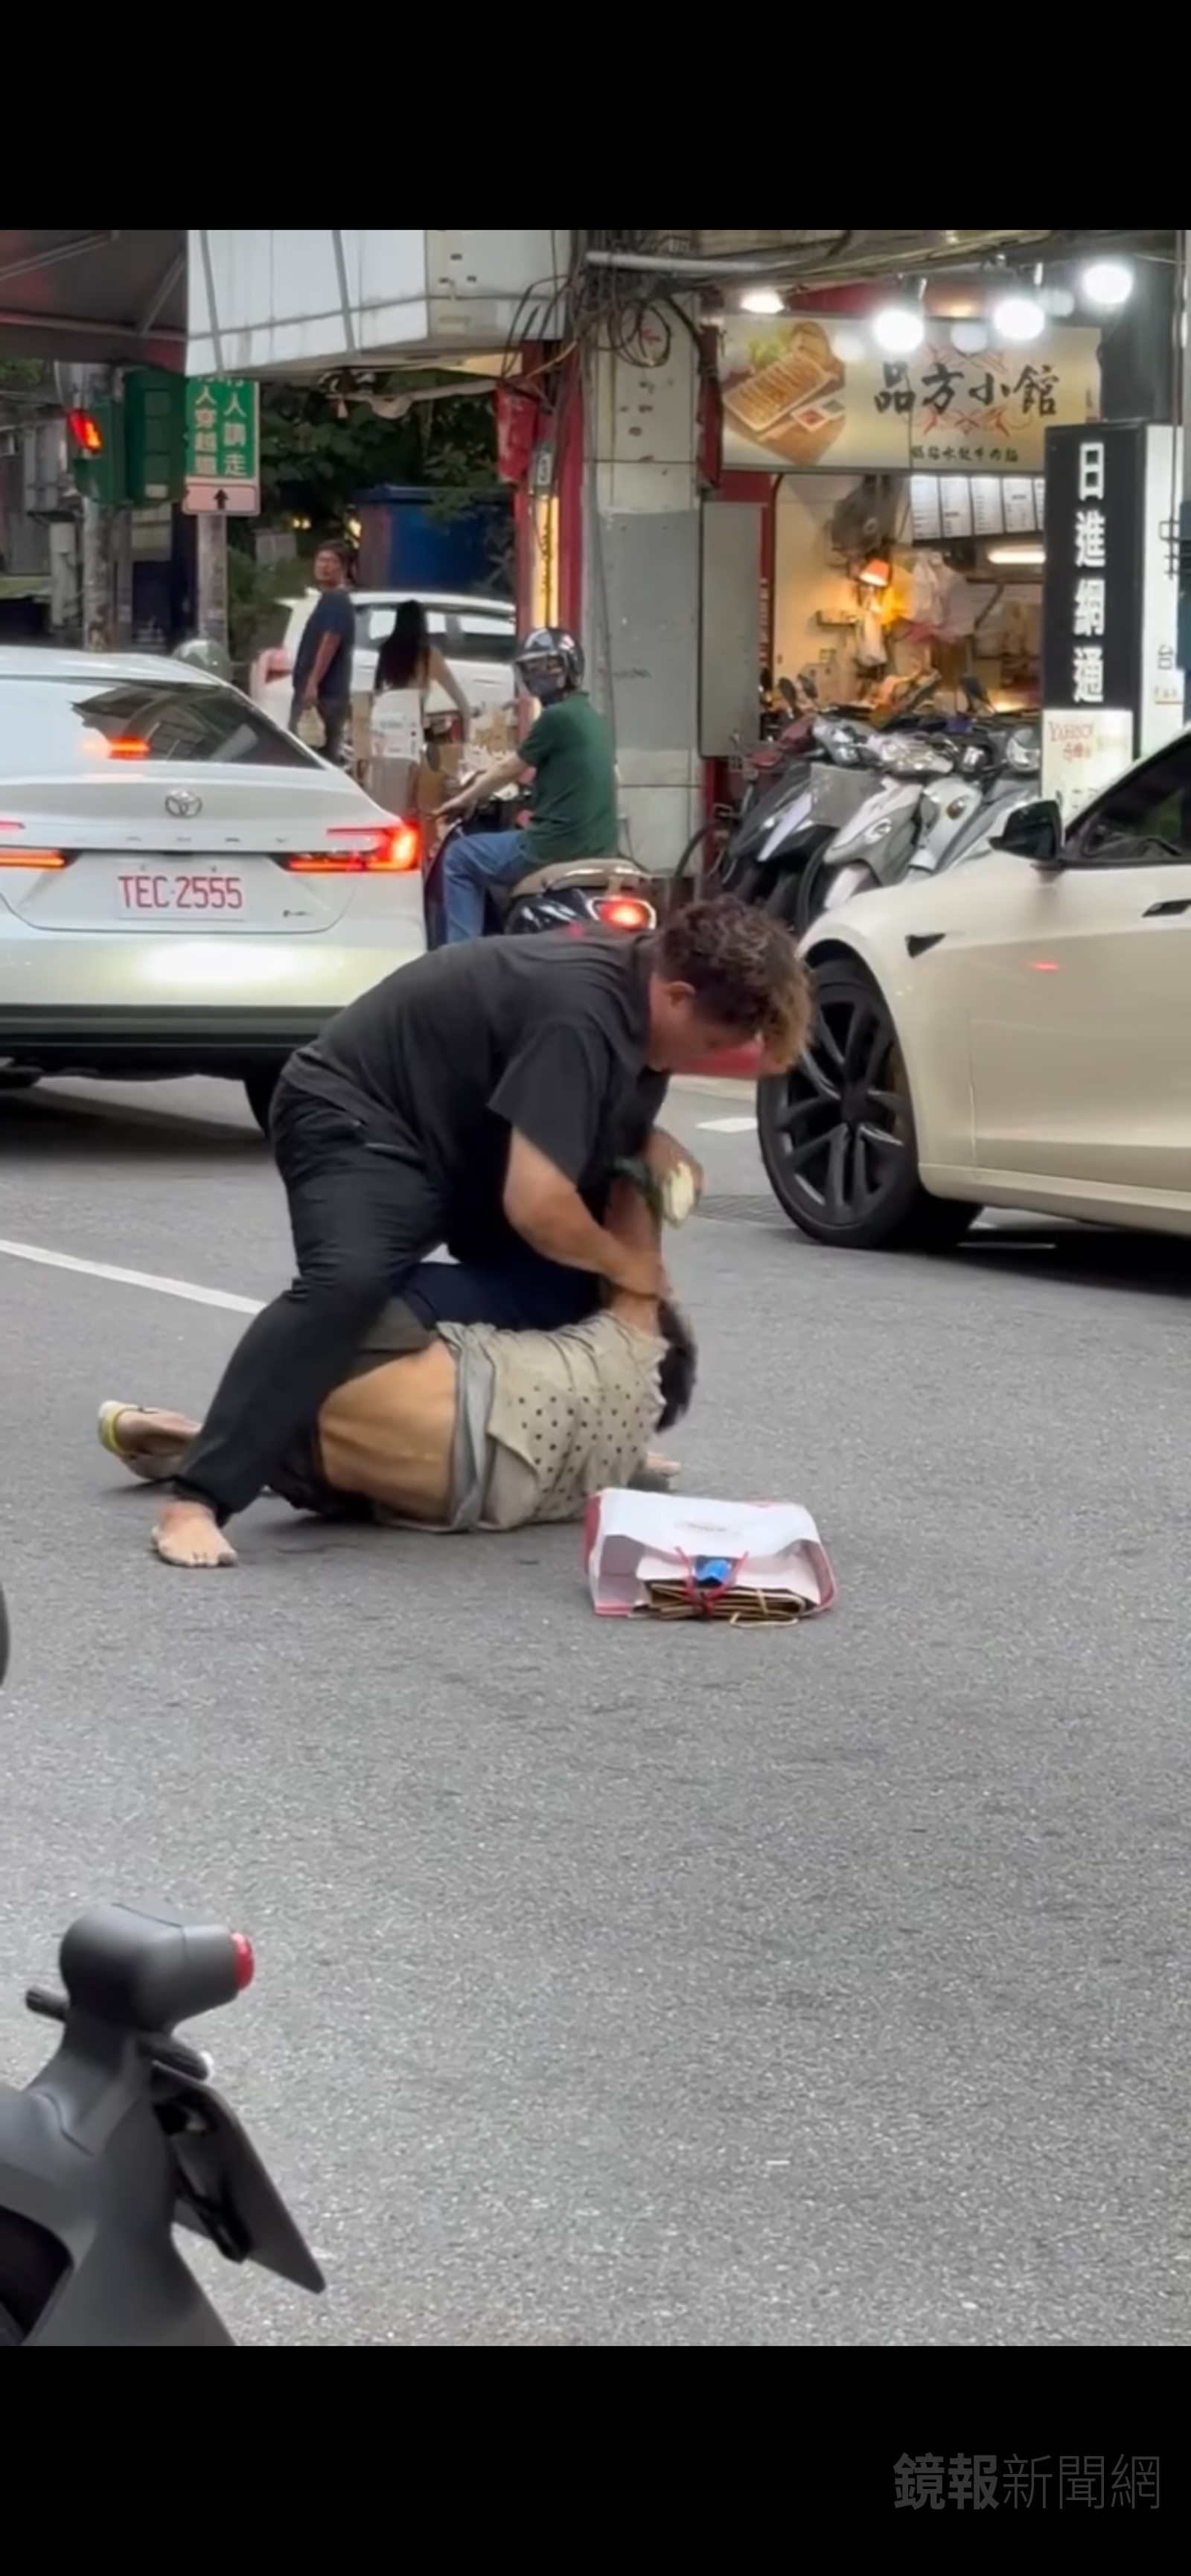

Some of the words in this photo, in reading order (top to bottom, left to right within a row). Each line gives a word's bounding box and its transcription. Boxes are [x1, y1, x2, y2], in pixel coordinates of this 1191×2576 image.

[874, 361, 1059, 418] 品方小館
[1073, 442, 1106, 703] 日進網通
[117, 875, 243, 910] TEC-2555
